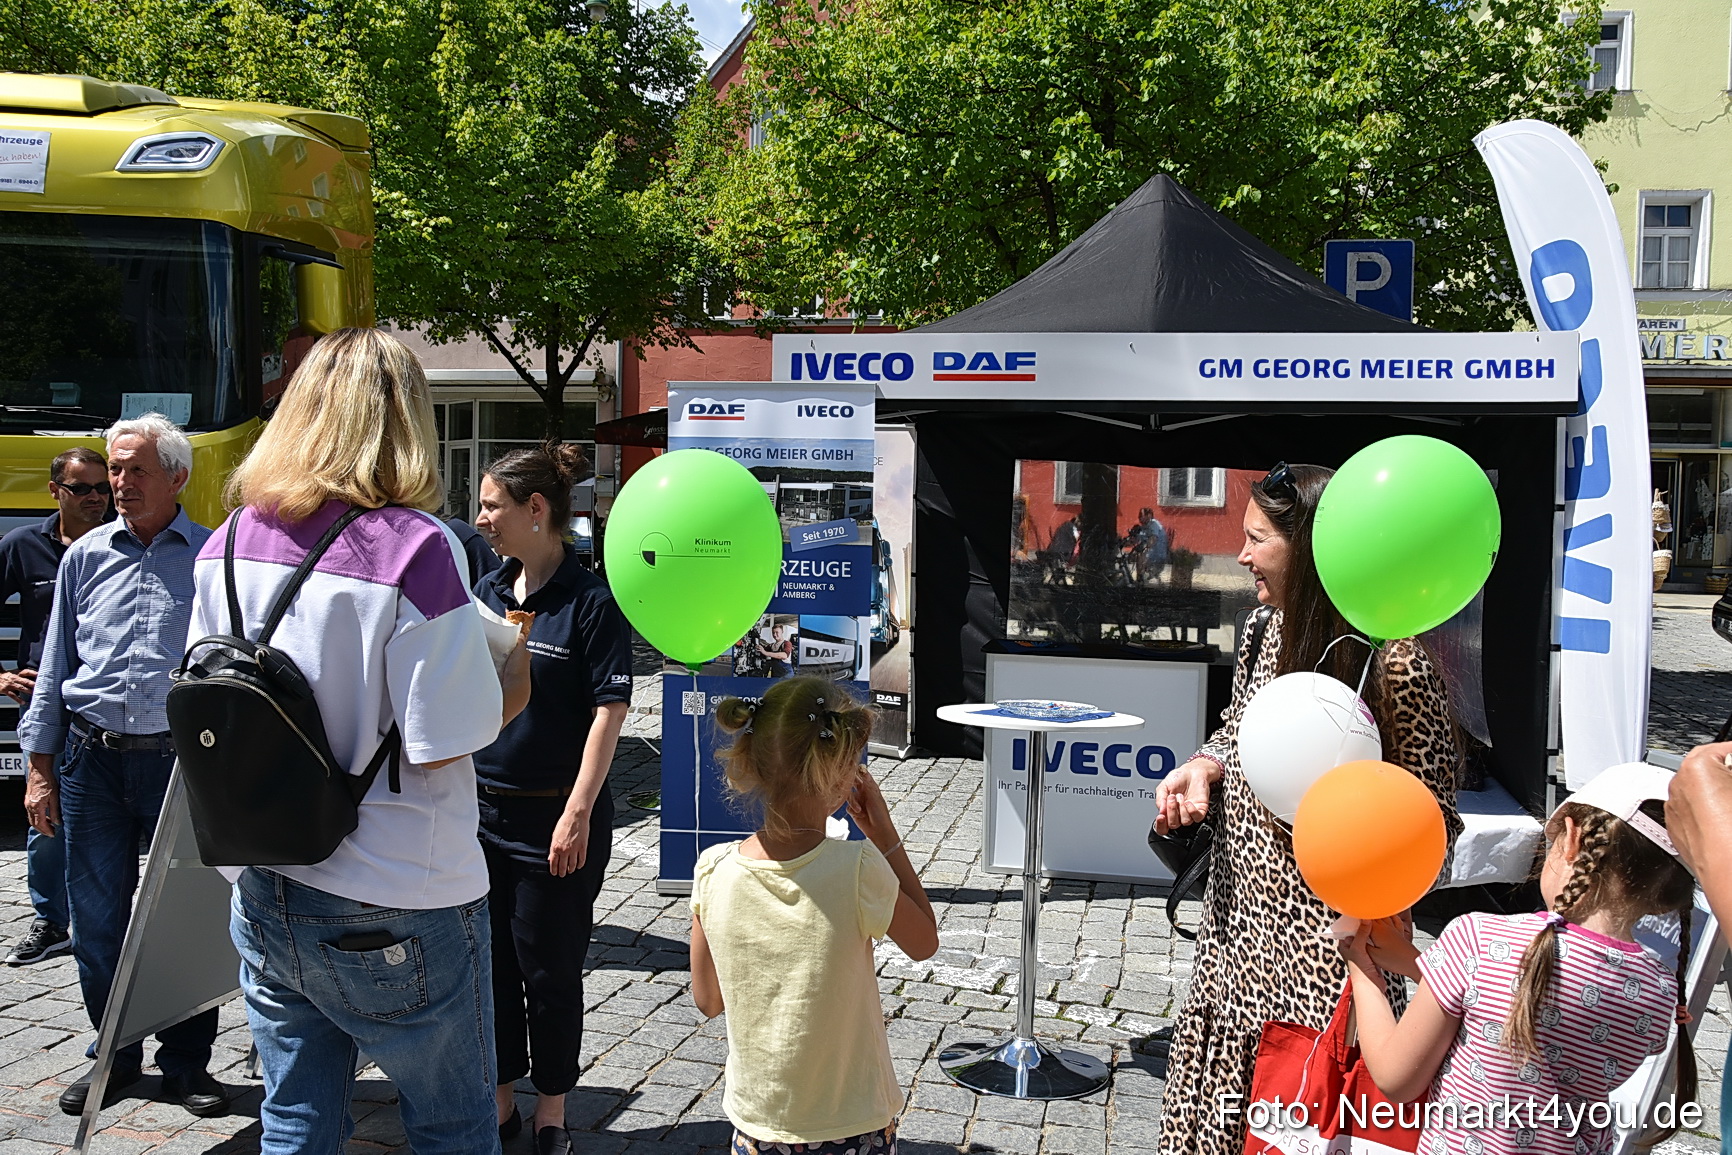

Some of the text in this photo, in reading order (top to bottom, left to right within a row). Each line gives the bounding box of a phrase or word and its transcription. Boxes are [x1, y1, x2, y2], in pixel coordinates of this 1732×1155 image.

[1346, 252, 1392, 303] P
[1638, 321, 1678, 329] AREN
[791, 351, 1036, 382] IVECO DAF
[1199, 358, 1555, 379] GM GEORG MEIER GMBH
[688, 404, 854, 418] DAF IVECO
[766, 447, 808, 460] MEIER
[811, 449, 854, 461] GMBH
[802, 526, 845, 542] Seit 1970
[694, 538, 731, 546] Klinikum
[782, 582, 835, 591] NEUMARKT &
[782, 591, 816, 599] AMBERG
[805, 647, 839, 659] DAF
[876, 694, 901, 702] DAF
[998, 780, 1012, 790] Ihr
[1015, 781, 1052, 792] Paer
[1055, 783, 1069, 794] für
[1073, 785, 1134, 800] nachhaltigen
